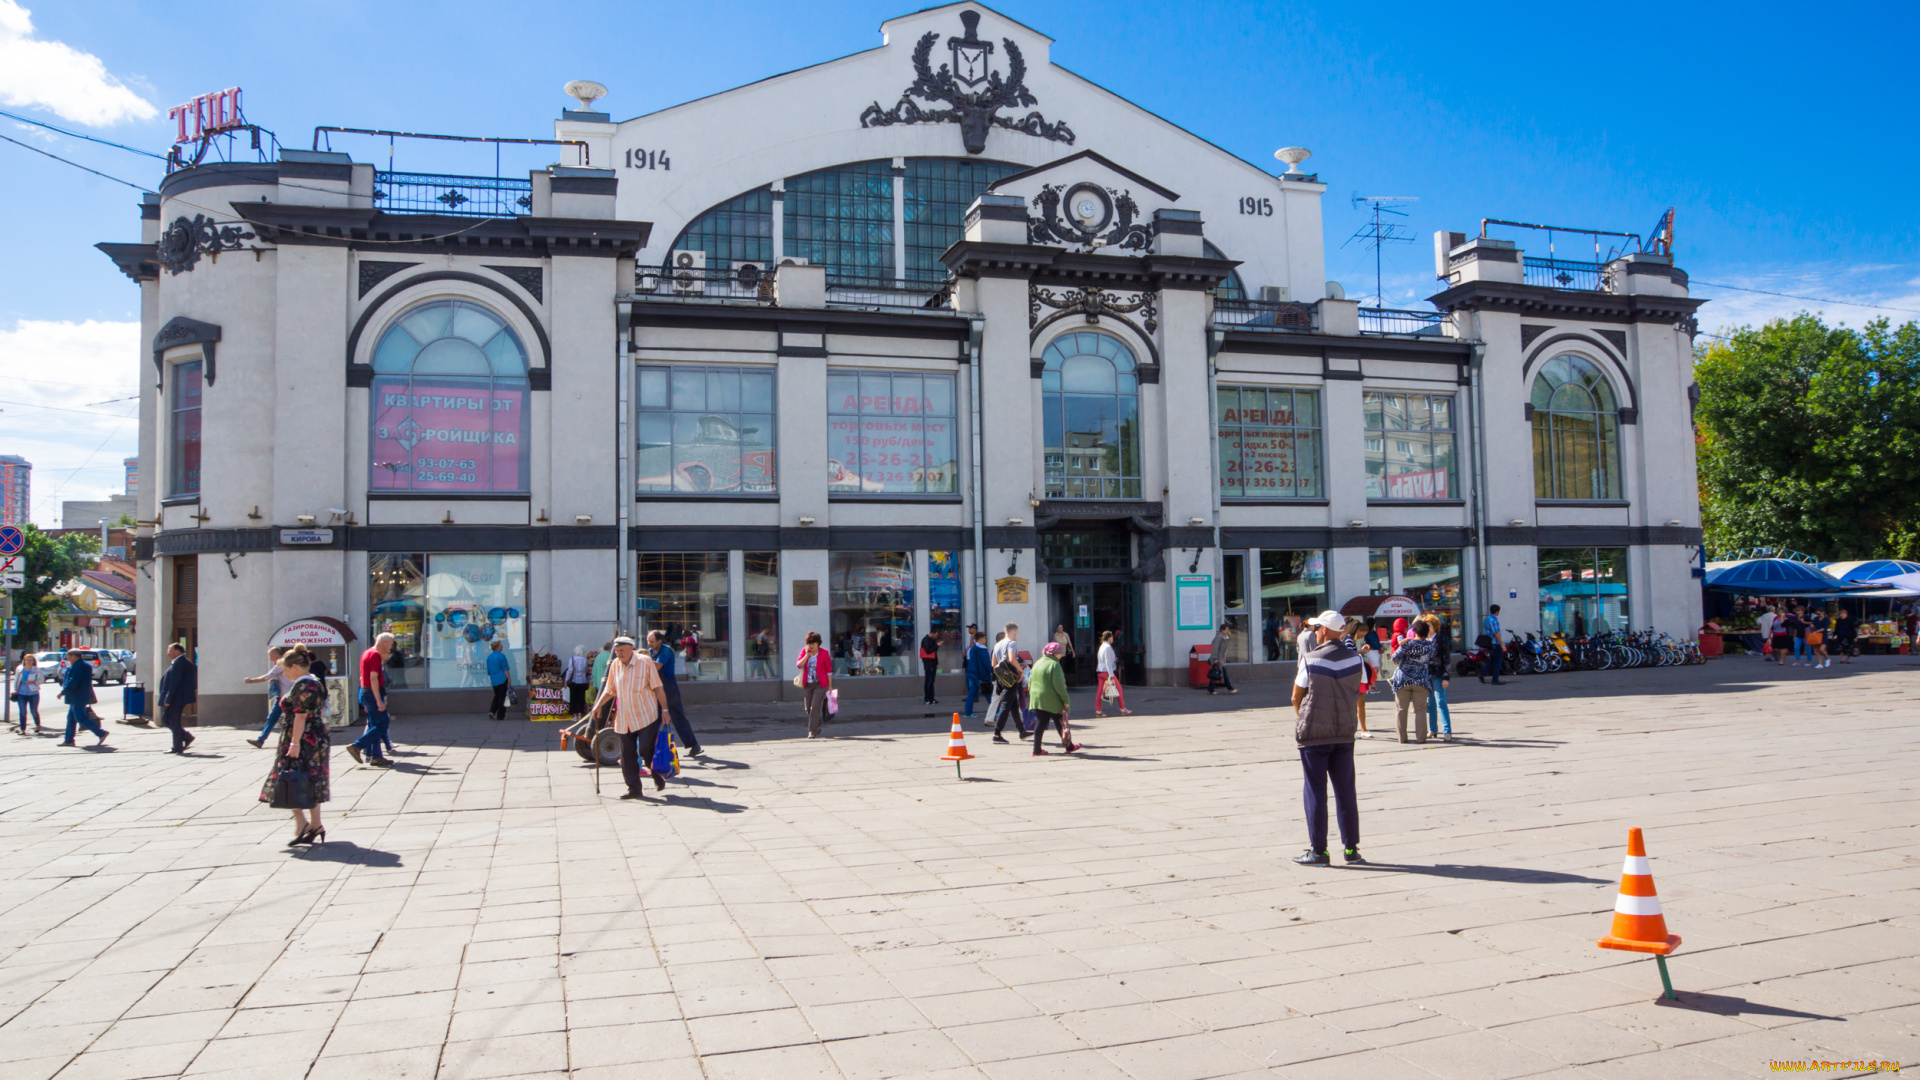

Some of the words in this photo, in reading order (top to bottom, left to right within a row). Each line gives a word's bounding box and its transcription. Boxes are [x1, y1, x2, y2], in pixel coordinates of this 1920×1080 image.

[625, 148, 671, 171] 1914
[1239, 196, 1274, 217] 1915
[384, 394, 484, 410] КВАРТИРЫ
[492, 399, 513, 412] ОТ
[842, 395, 934, 414] АРЕНДА
[1223, 408, 1299, 426] АРЕНДА
[843, 435, 870, 446] 150
[1218, 430, 1260, 439] оргоых
[417, 458, 476, 470] 93-07-63
[417, 471, 476, 483] 25-69-40
[846, 471, 873, 481] 97
[877, 471, 904, 482] 326
[907, 471, 923, 482] 37
[926, 472, 944, 482] 07
[1253, 478, 1276, 488] 326
[1279, 478, 1293, 488] 37
[284, 623, 336, 636] ГАЗИРОВАННАЯ
[536, 687, 563, 699] НАР
